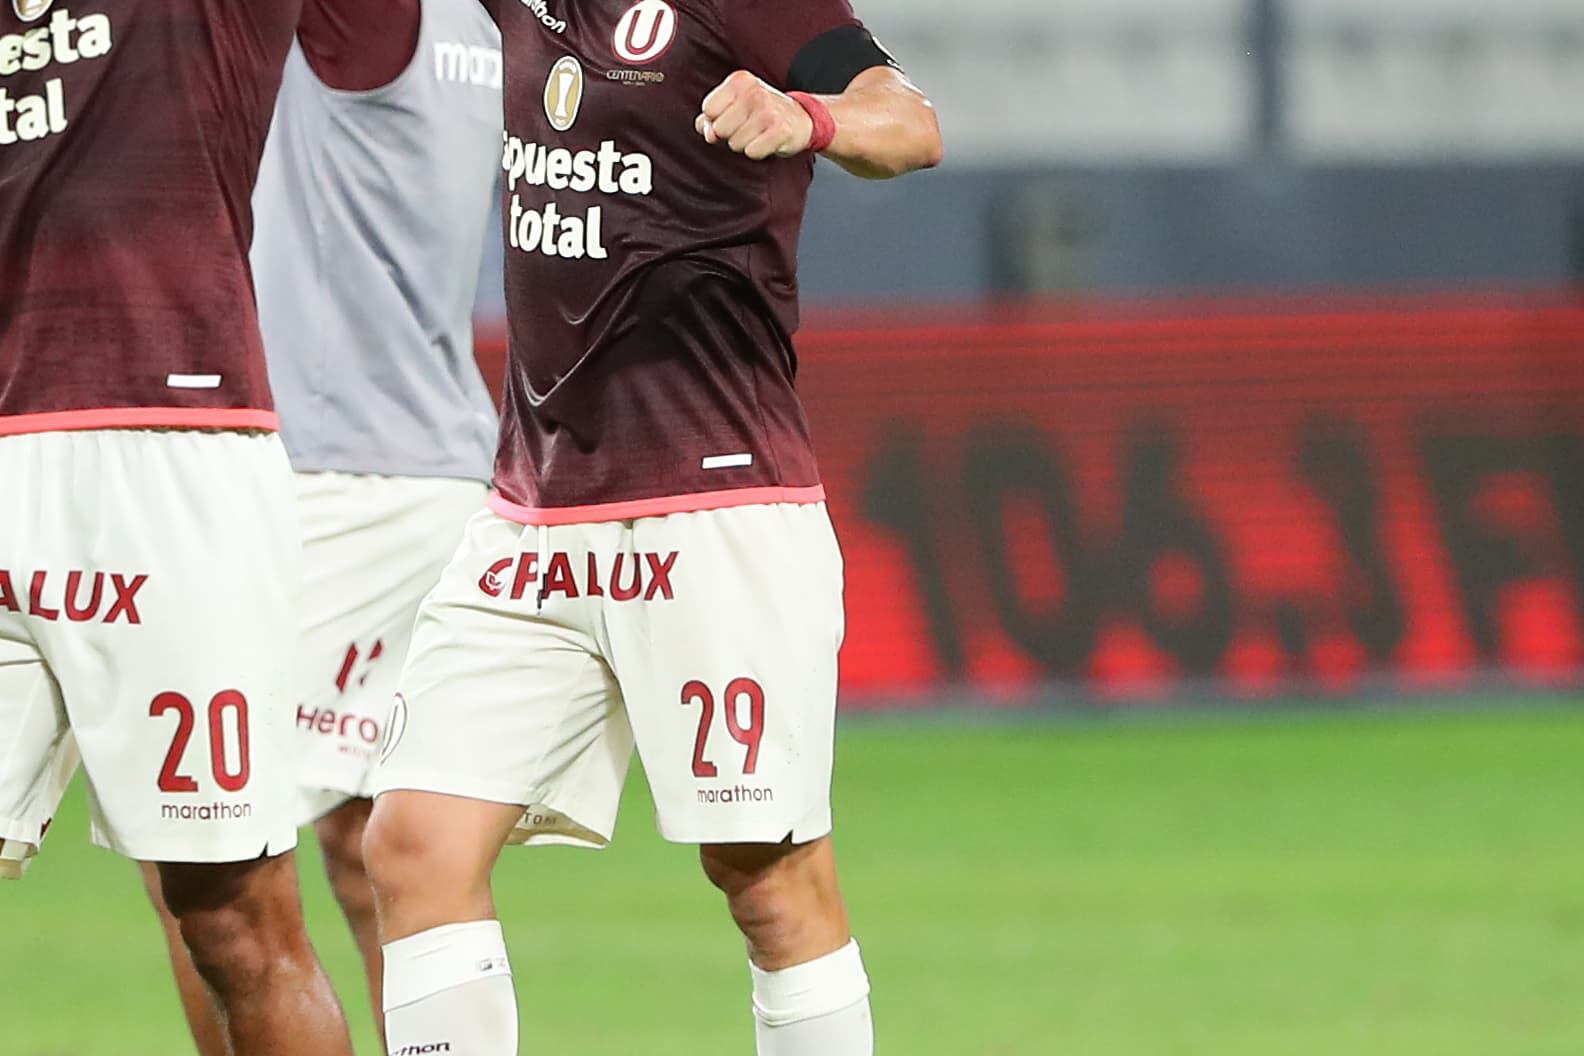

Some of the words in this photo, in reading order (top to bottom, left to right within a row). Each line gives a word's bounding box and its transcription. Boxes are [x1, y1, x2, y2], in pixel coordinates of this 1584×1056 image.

[509, 194, 609, 260] total
[148, 688, 251, 793] 20
[680, 677, 766, 778] 29
[161, 800, 253, 822] marathon
[697, 784, 774, 804] marathon
